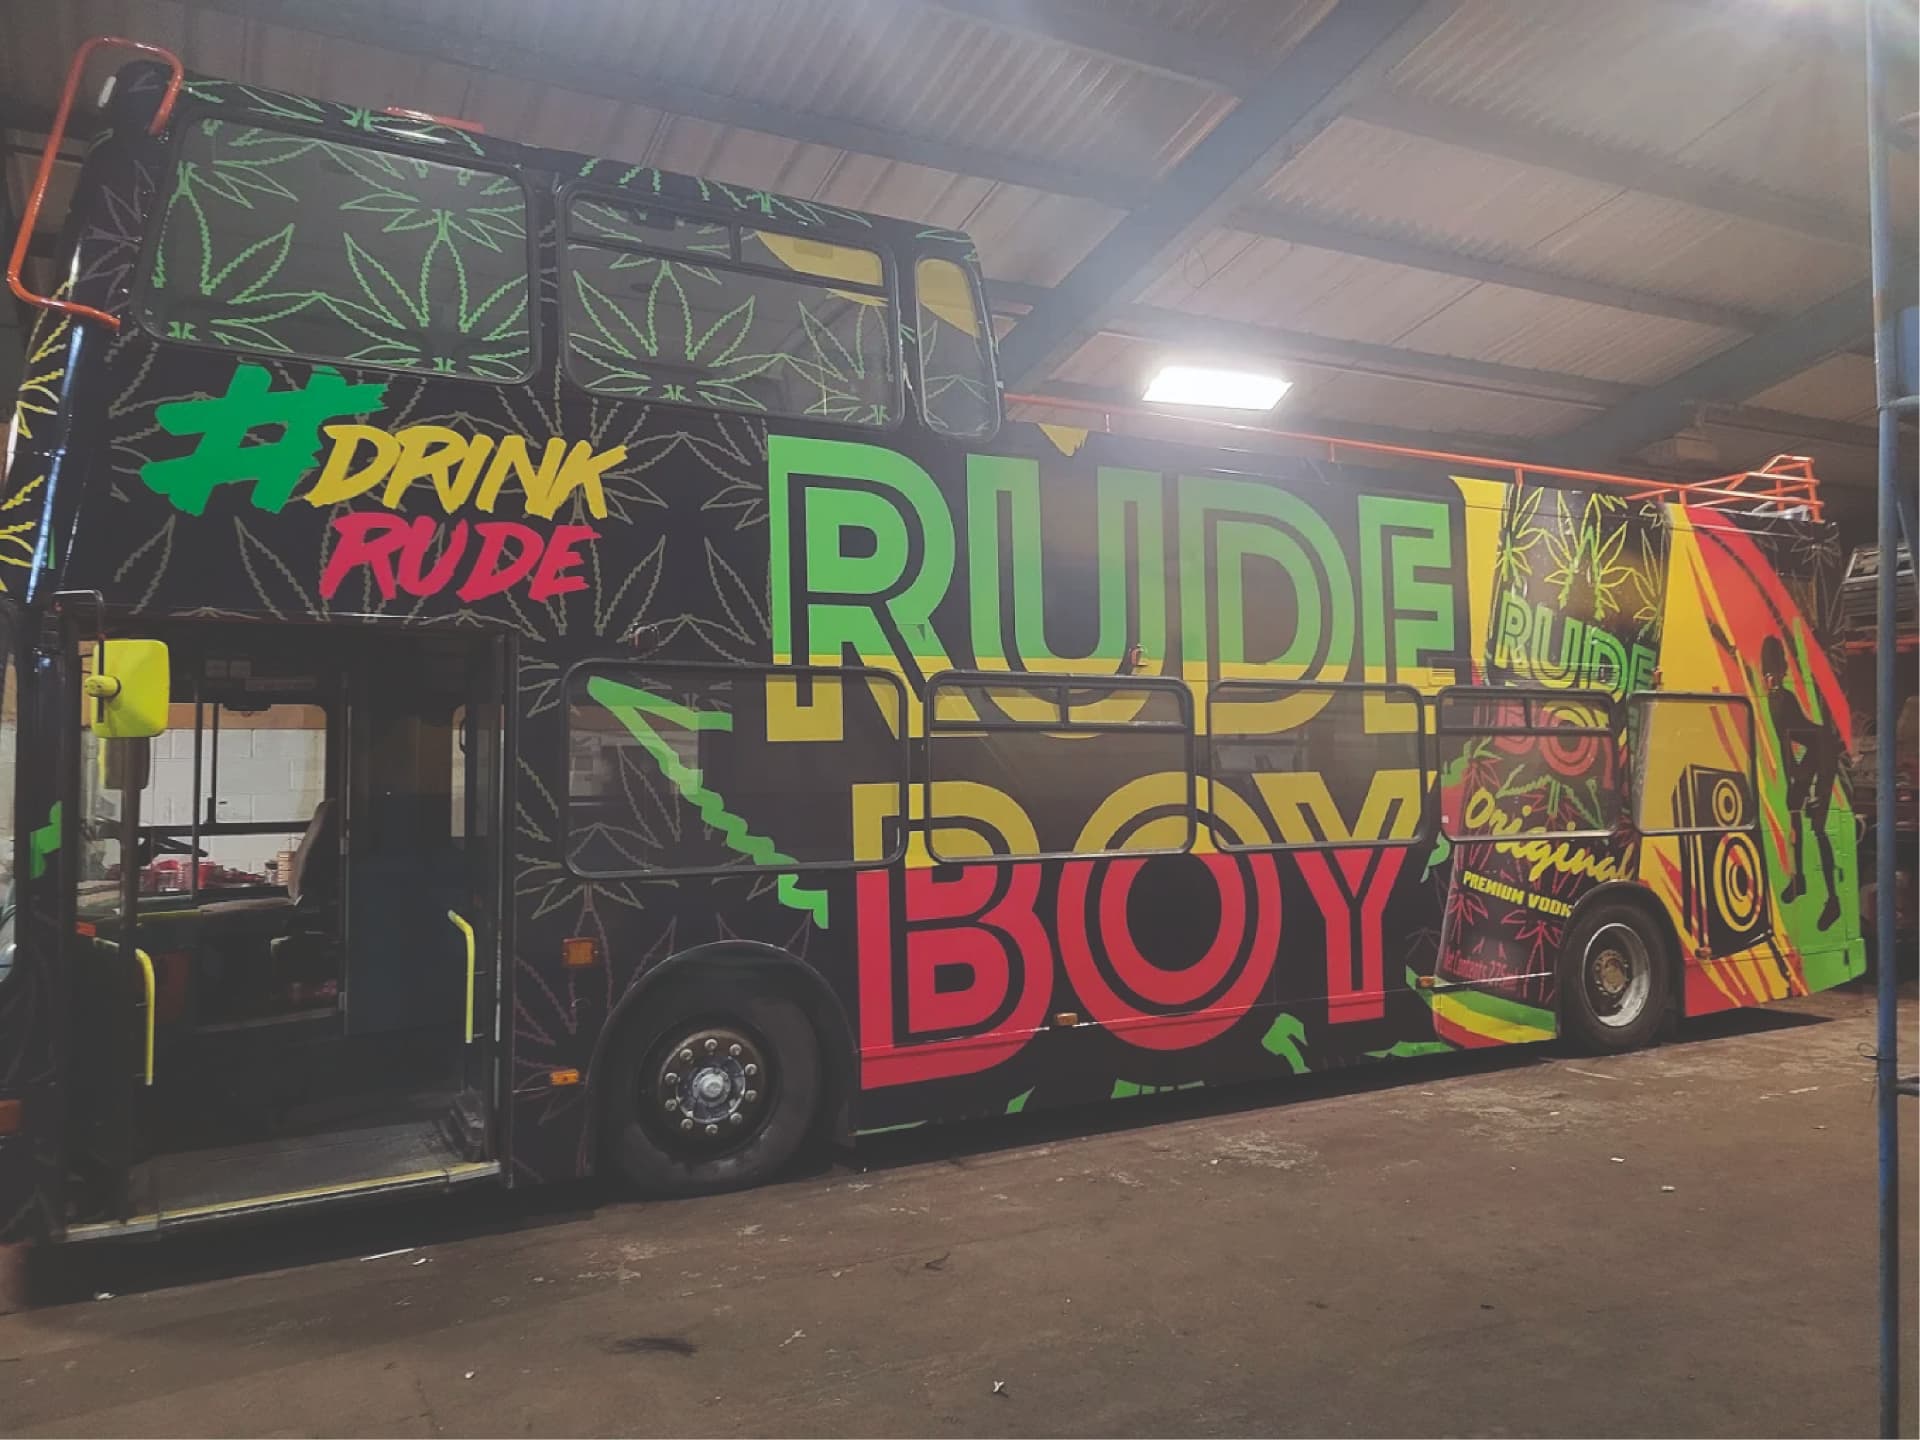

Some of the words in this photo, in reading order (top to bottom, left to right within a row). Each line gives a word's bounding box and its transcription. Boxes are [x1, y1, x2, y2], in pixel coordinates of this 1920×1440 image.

[140, 361, 628, 520] #DRINK
[318, 512, 602, 602] RUDE
[767, 434, 1455, 740] RUDE
[1494, 590, 1657, 705] RUDE
[1463, 870, 1526, 905] PREMIUM
[1464, 786, 1635, 883] Original
[851, 768, 1437, 1091] BOY
